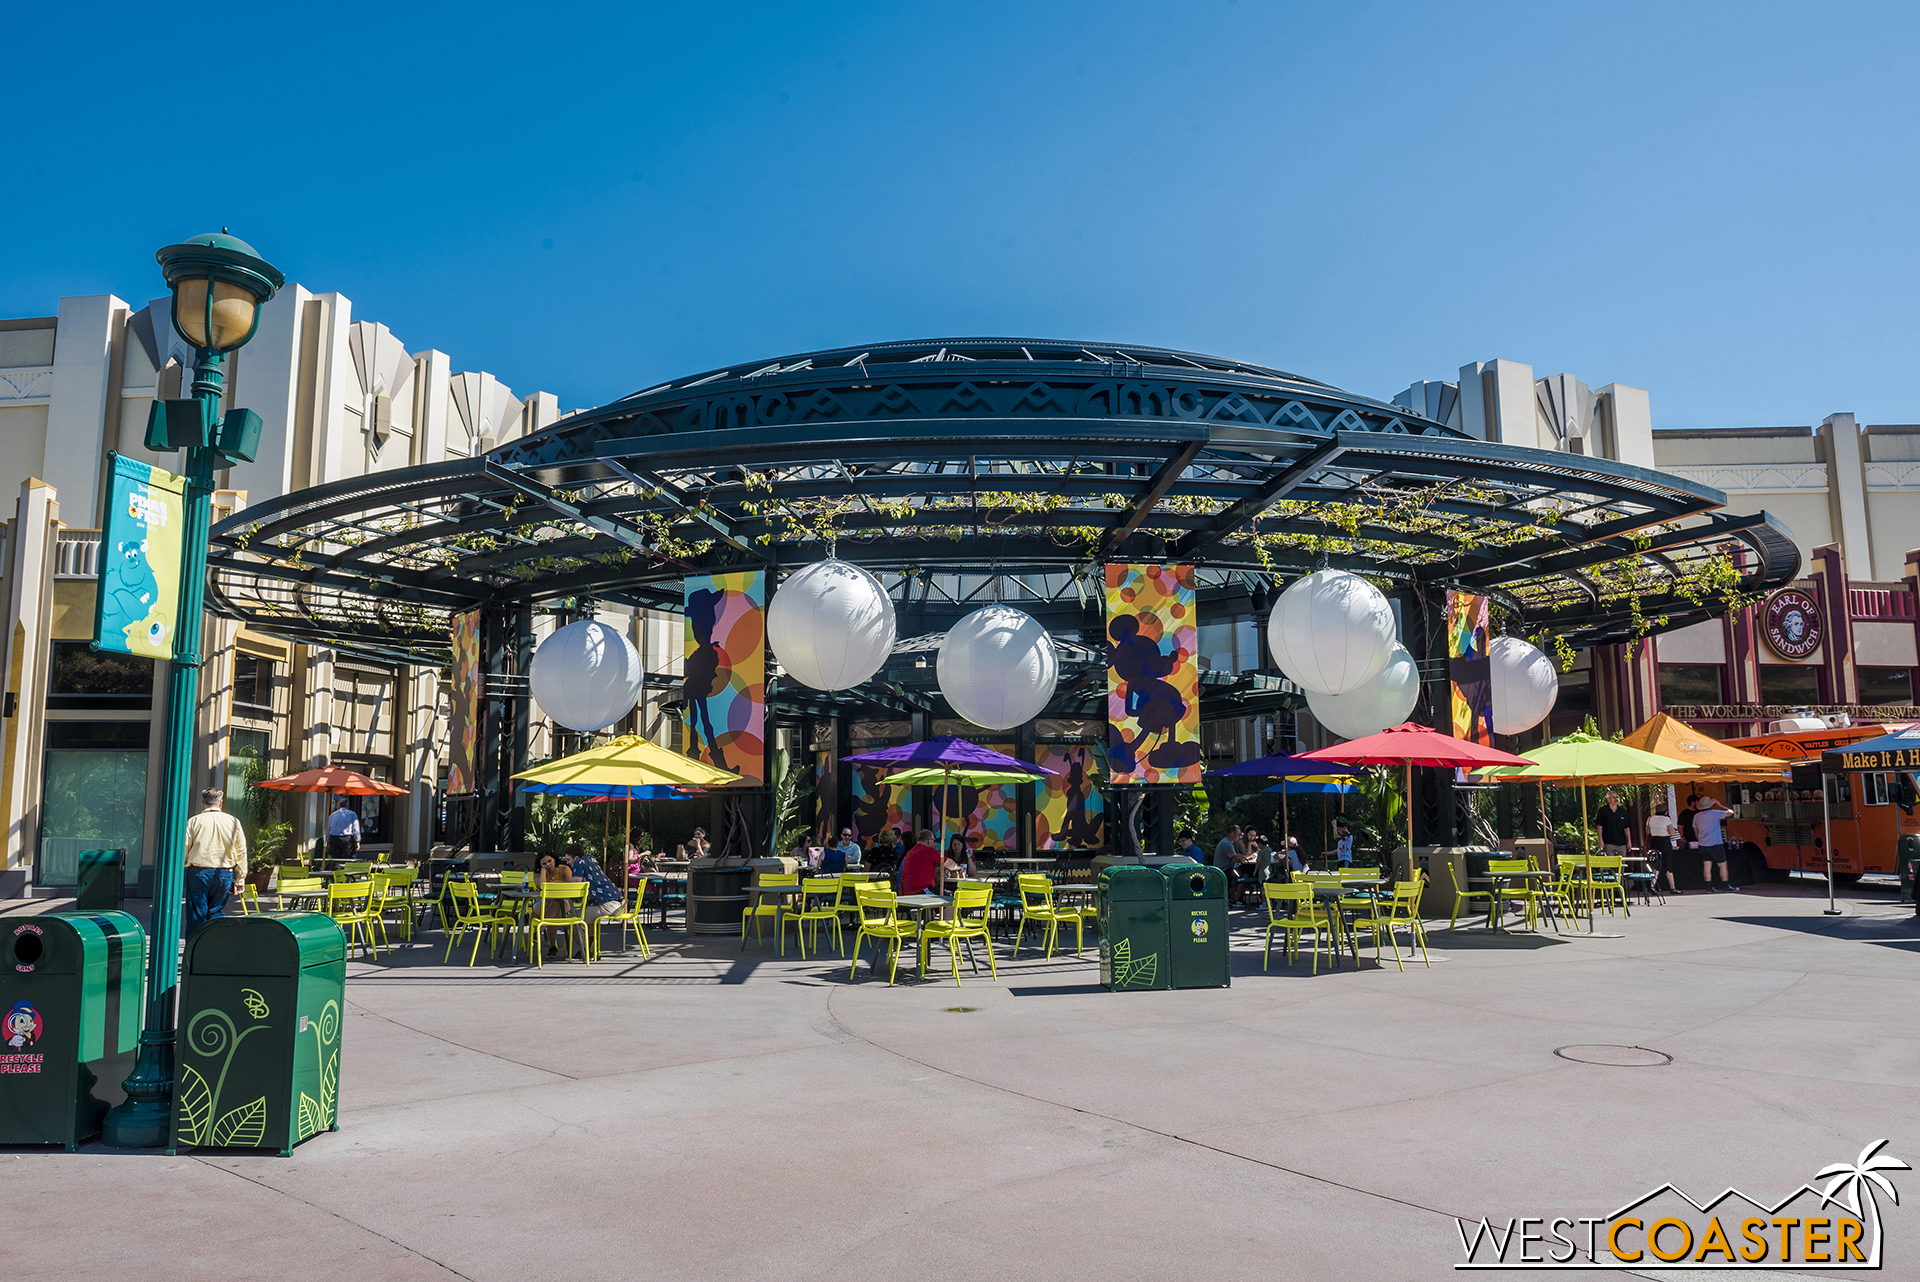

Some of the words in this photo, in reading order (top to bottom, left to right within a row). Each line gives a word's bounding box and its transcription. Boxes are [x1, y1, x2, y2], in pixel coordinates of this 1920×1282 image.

[1076, 382, 1204, 420] amc
[129, 492, 167, 515] PIXAR
[137, 507, 168, 527] FEST
[1771, 595, 1799, 614] EARL
[1801, 600, 1815, 615] OF
[1771, 628, 1818, 654] SANDWICH
[1665, 704, 1697, 718] THE
[1698, 704, 1763, 718] WORLD'S
[1861, 705, 1920, 718] SANDWIC
[1842, 752, 1878, 768] Make
[1880, 750, 1891, 767] It
[1895, 750, 1906, 766] A
[13, 924, 44, 936] BOTTLES
[15, 963, 35, 972] CANS
[0, 1054, 44, 1063] RECYCLE
[1, 1064, 41, 1073] PLEASE
